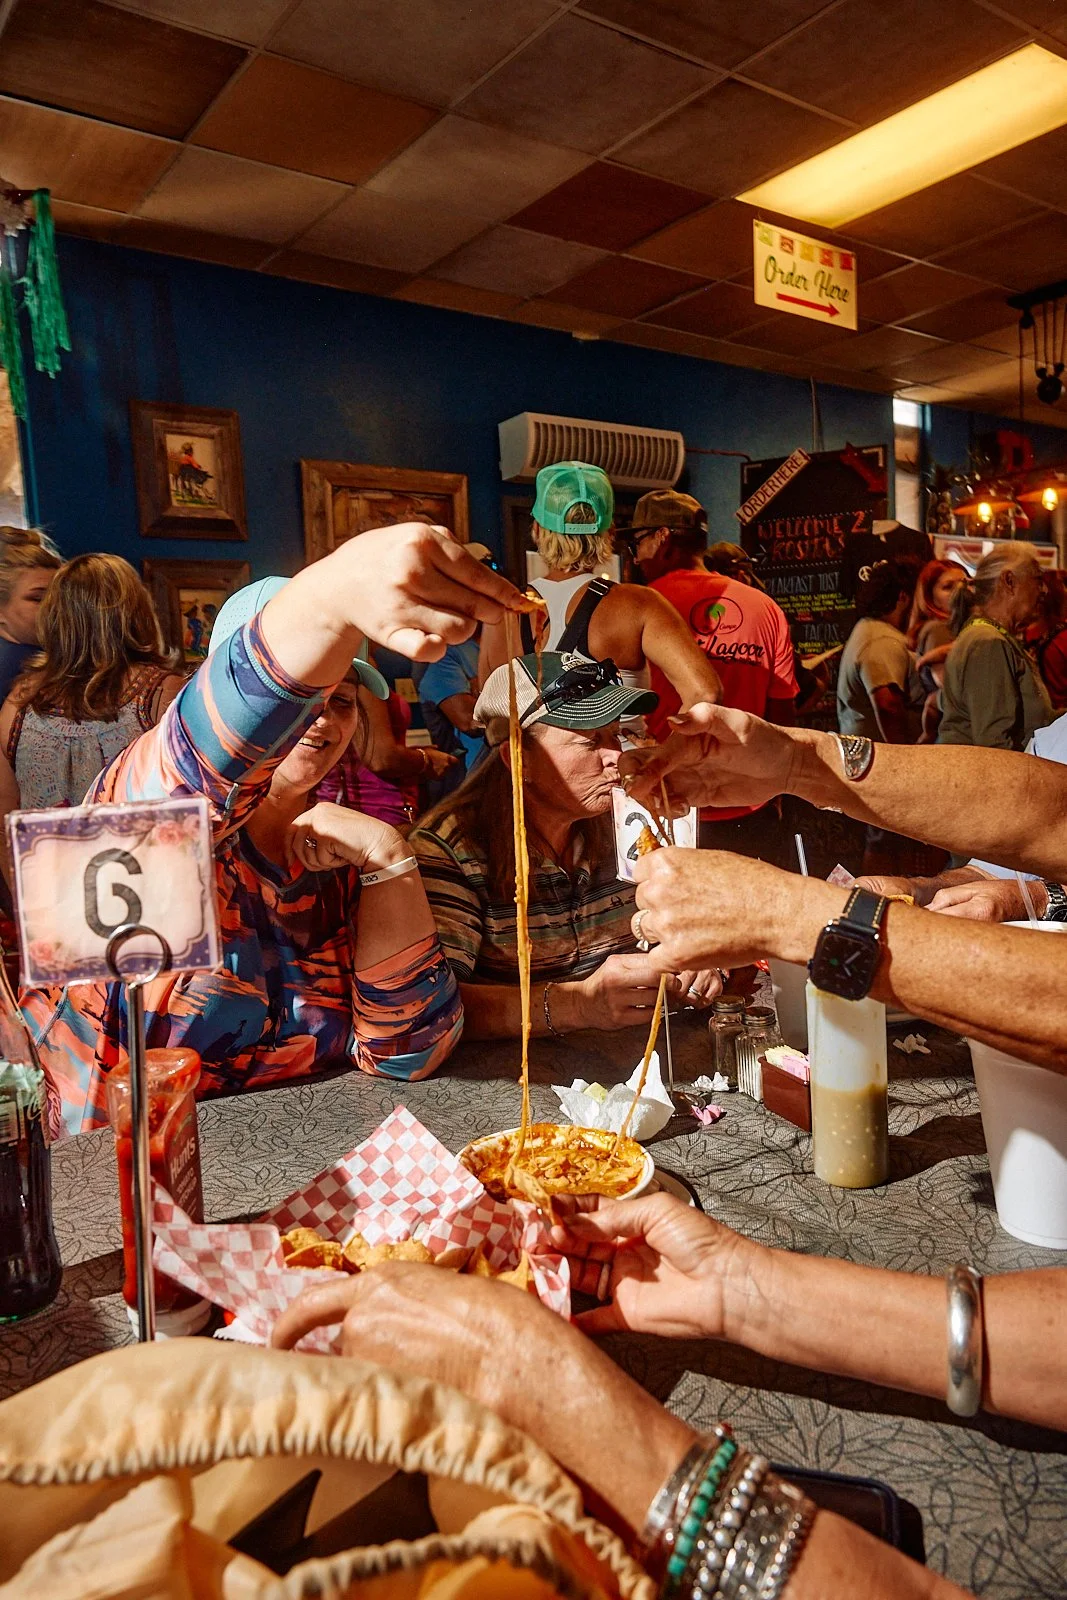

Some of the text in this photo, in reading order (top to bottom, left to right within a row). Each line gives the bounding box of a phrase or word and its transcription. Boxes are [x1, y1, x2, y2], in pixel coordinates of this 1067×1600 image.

[764, 255, 849, 303] Order Here
[742, 455, 802, 519] ORDER HERE
[851, 511, 867, 533] 2
[763, 574, 816, 595] REAKFAST
[84, 848, 142, 940] 6
